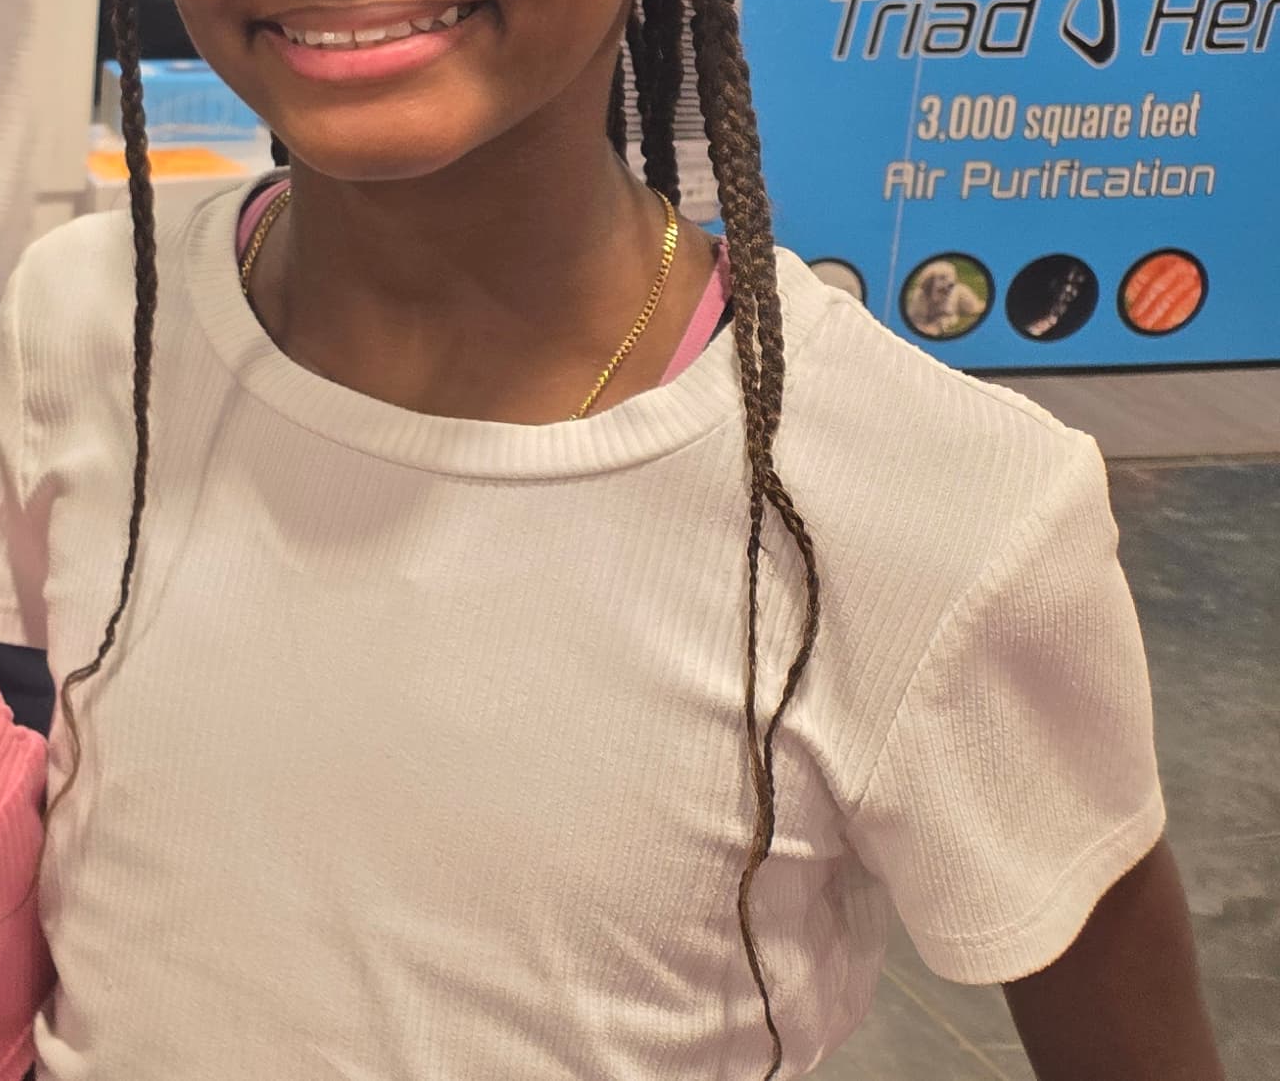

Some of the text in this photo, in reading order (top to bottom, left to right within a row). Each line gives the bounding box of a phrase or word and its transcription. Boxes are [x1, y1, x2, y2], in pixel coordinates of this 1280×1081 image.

[1024, 103, 1132, 147] square
[1139, 91, 1201, 139] feet
[883, 159, 1216, 199] Air Purification
